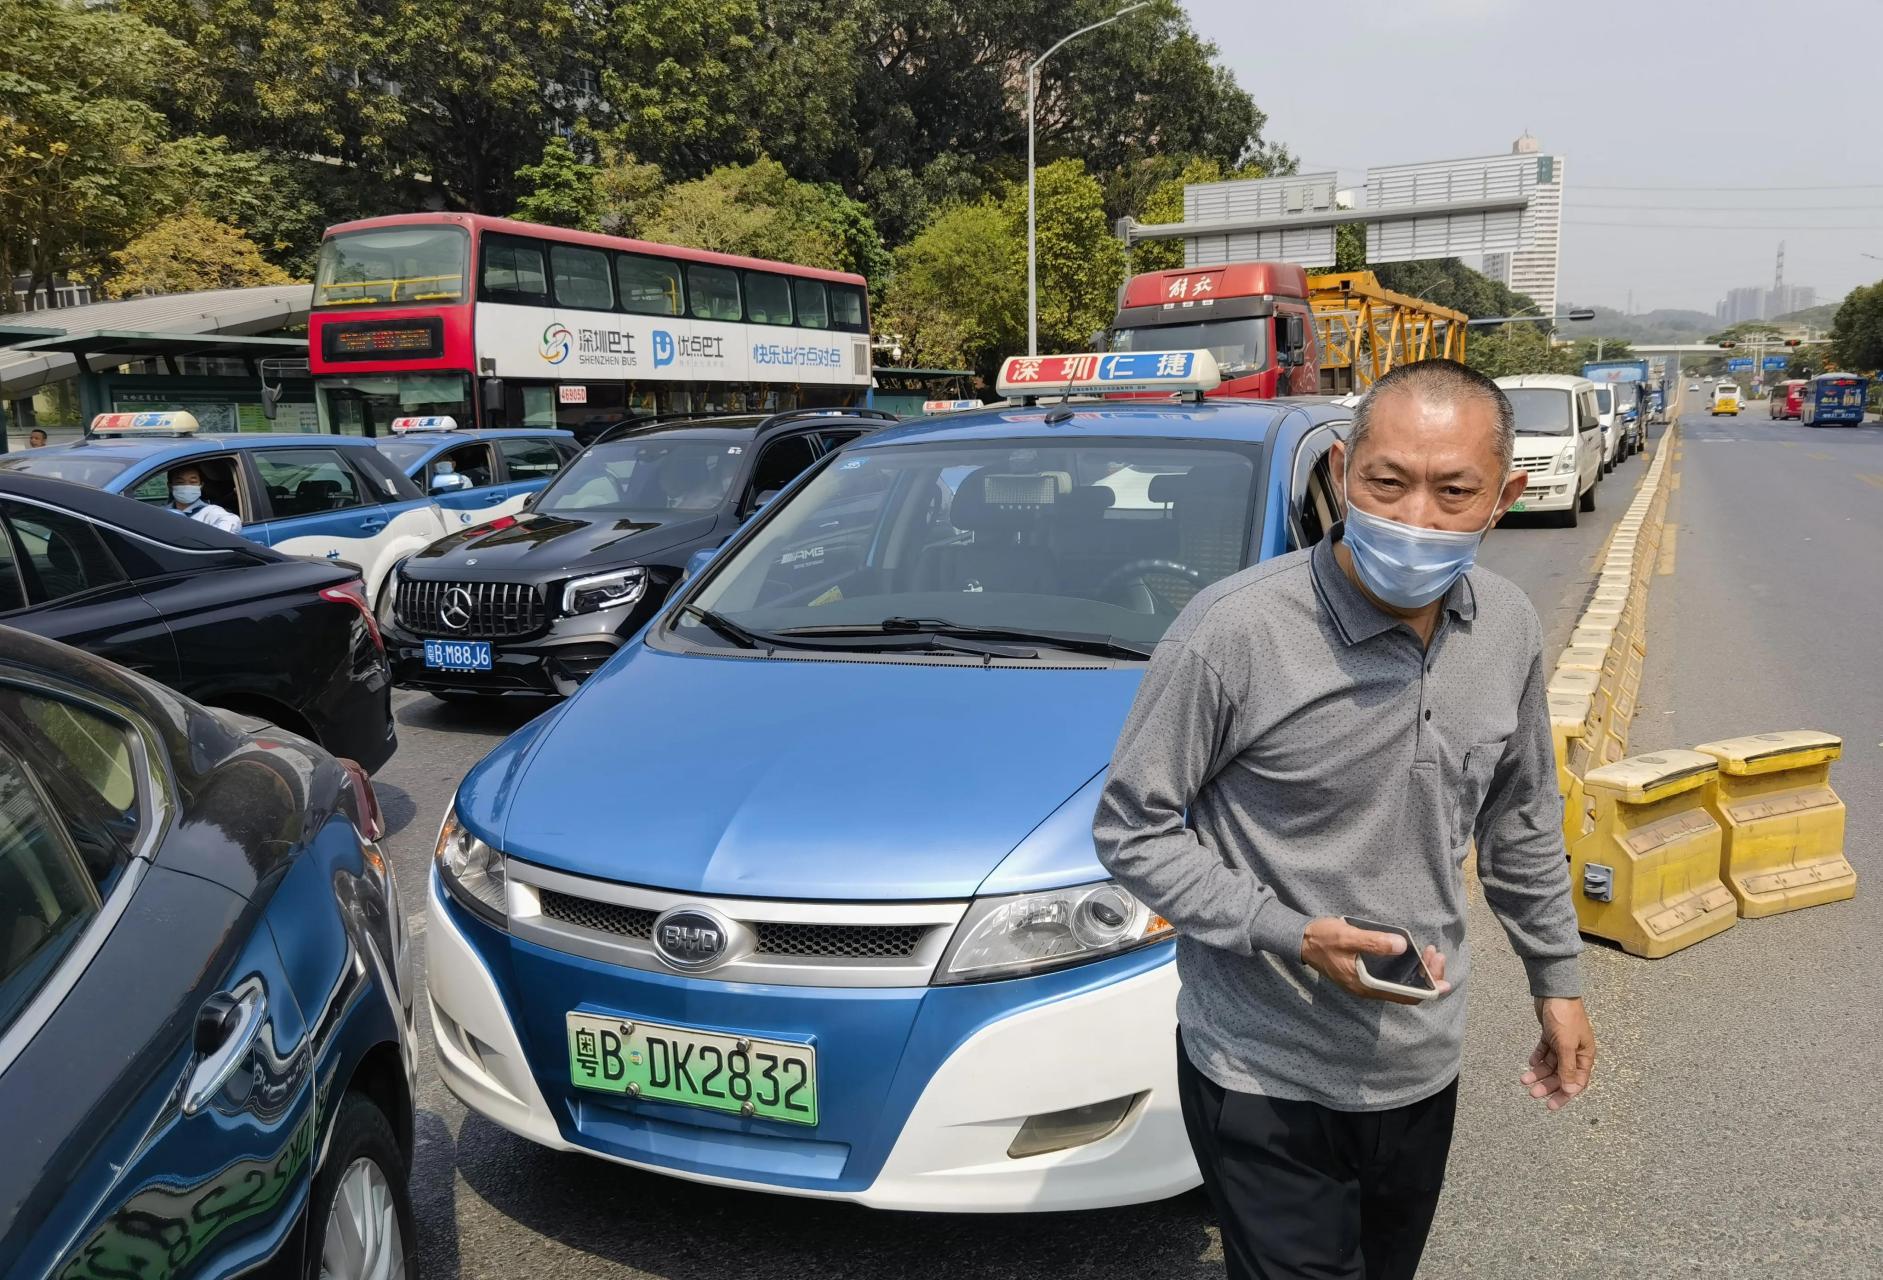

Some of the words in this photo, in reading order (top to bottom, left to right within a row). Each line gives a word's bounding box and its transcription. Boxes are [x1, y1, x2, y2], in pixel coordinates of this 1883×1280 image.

[579, 329, 635, 354] 深圳巴士
[678, 335, 724, 358] 优点巴士
[579, 355, 620, 366] SHENZHEN
[621, 356, 637, 366] BUS
[753, 343, 841, 368] 快乐出行点对点
[1012, 357, 1091, 381] 深圳
[1106, 354, 1188, 379] 仁捷
[795, 547, 824, 560] AMG
[662, 925, 718, 951] BYD
